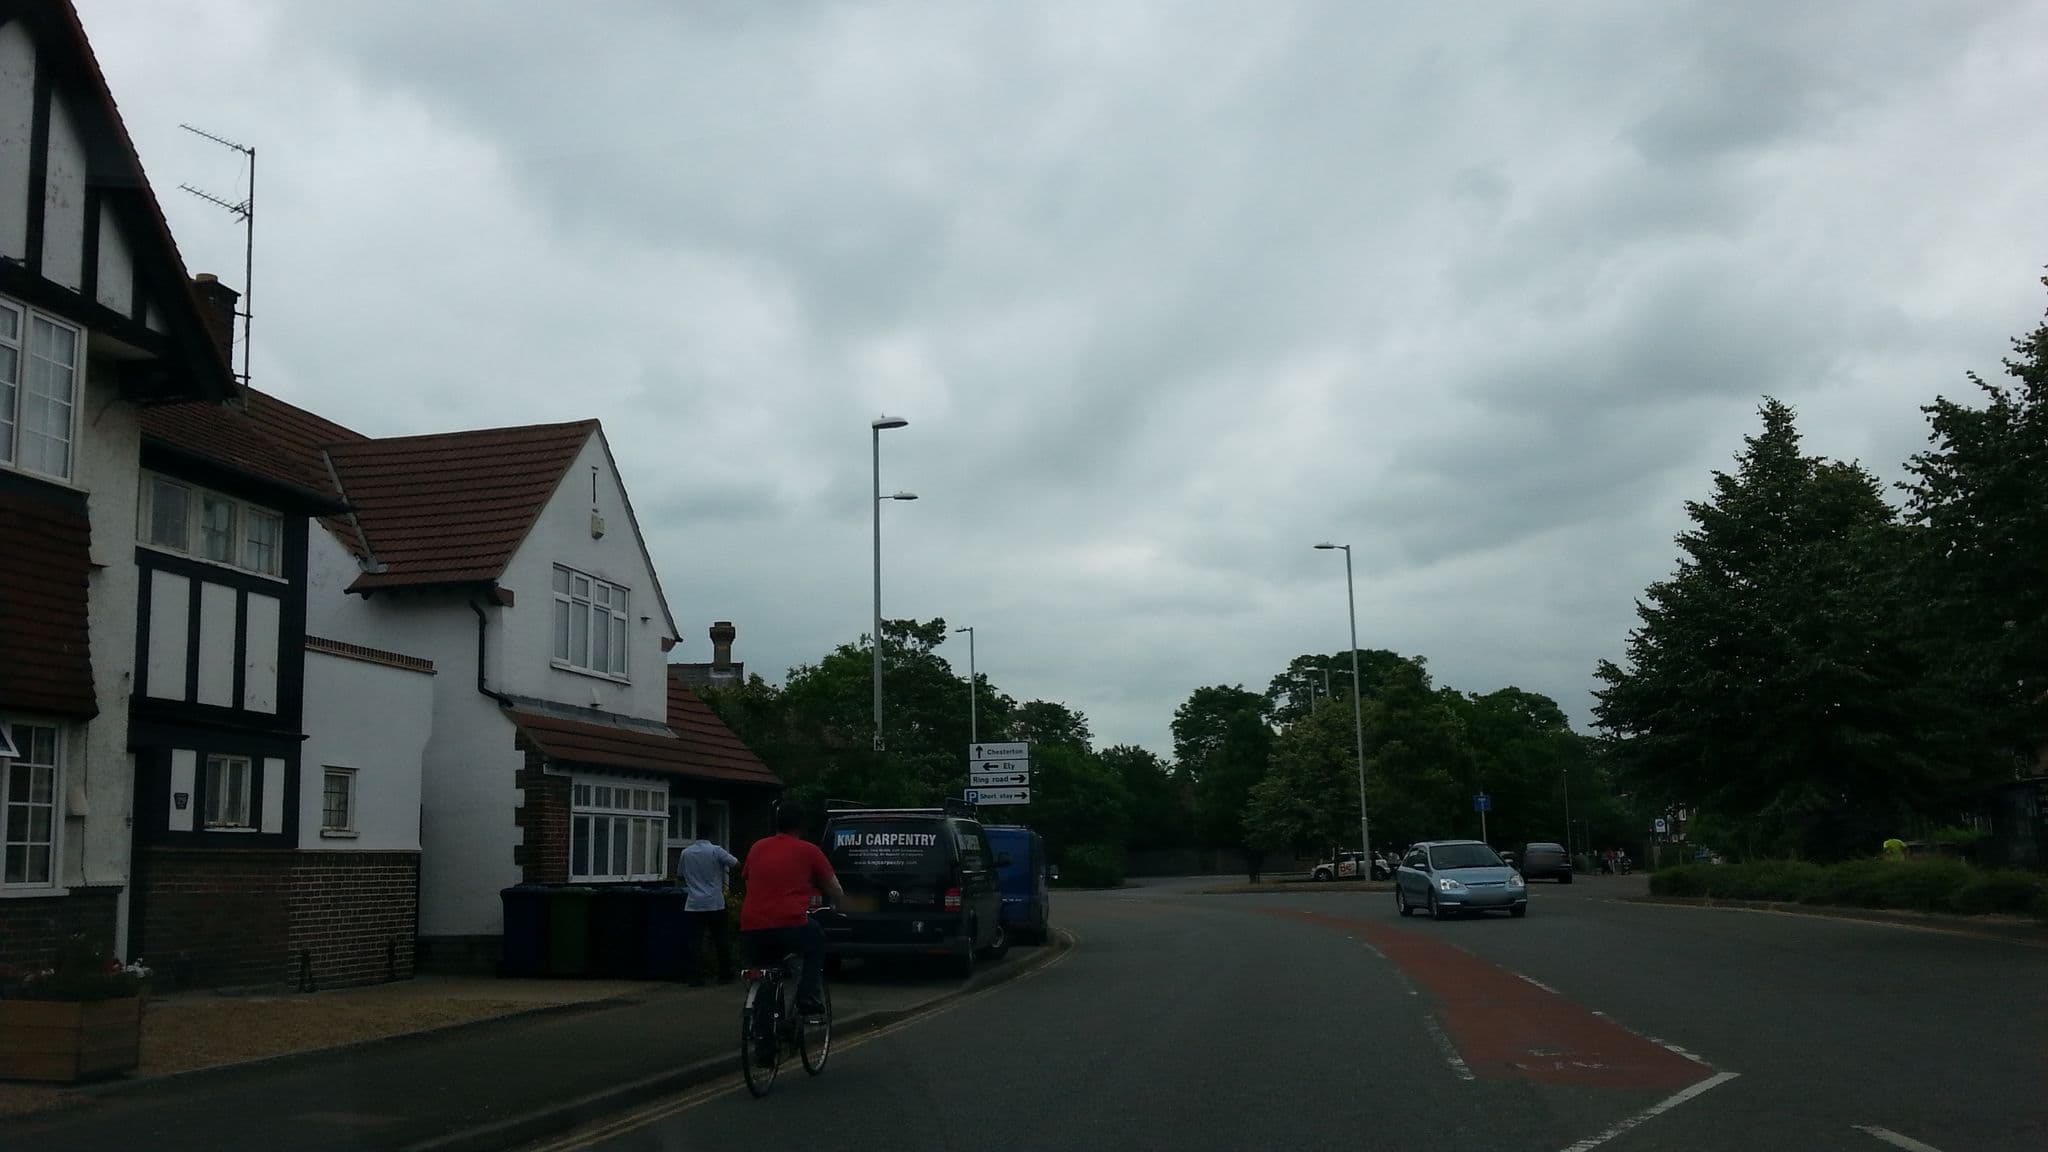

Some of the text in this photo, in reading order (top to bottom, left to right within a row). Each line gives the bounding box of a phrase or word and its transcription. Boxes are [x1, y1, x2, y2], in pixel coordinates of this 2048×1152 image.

[973, 776, 990, 784] Ring
[837, 833, 937, 847] KMJ CARPENTRY
